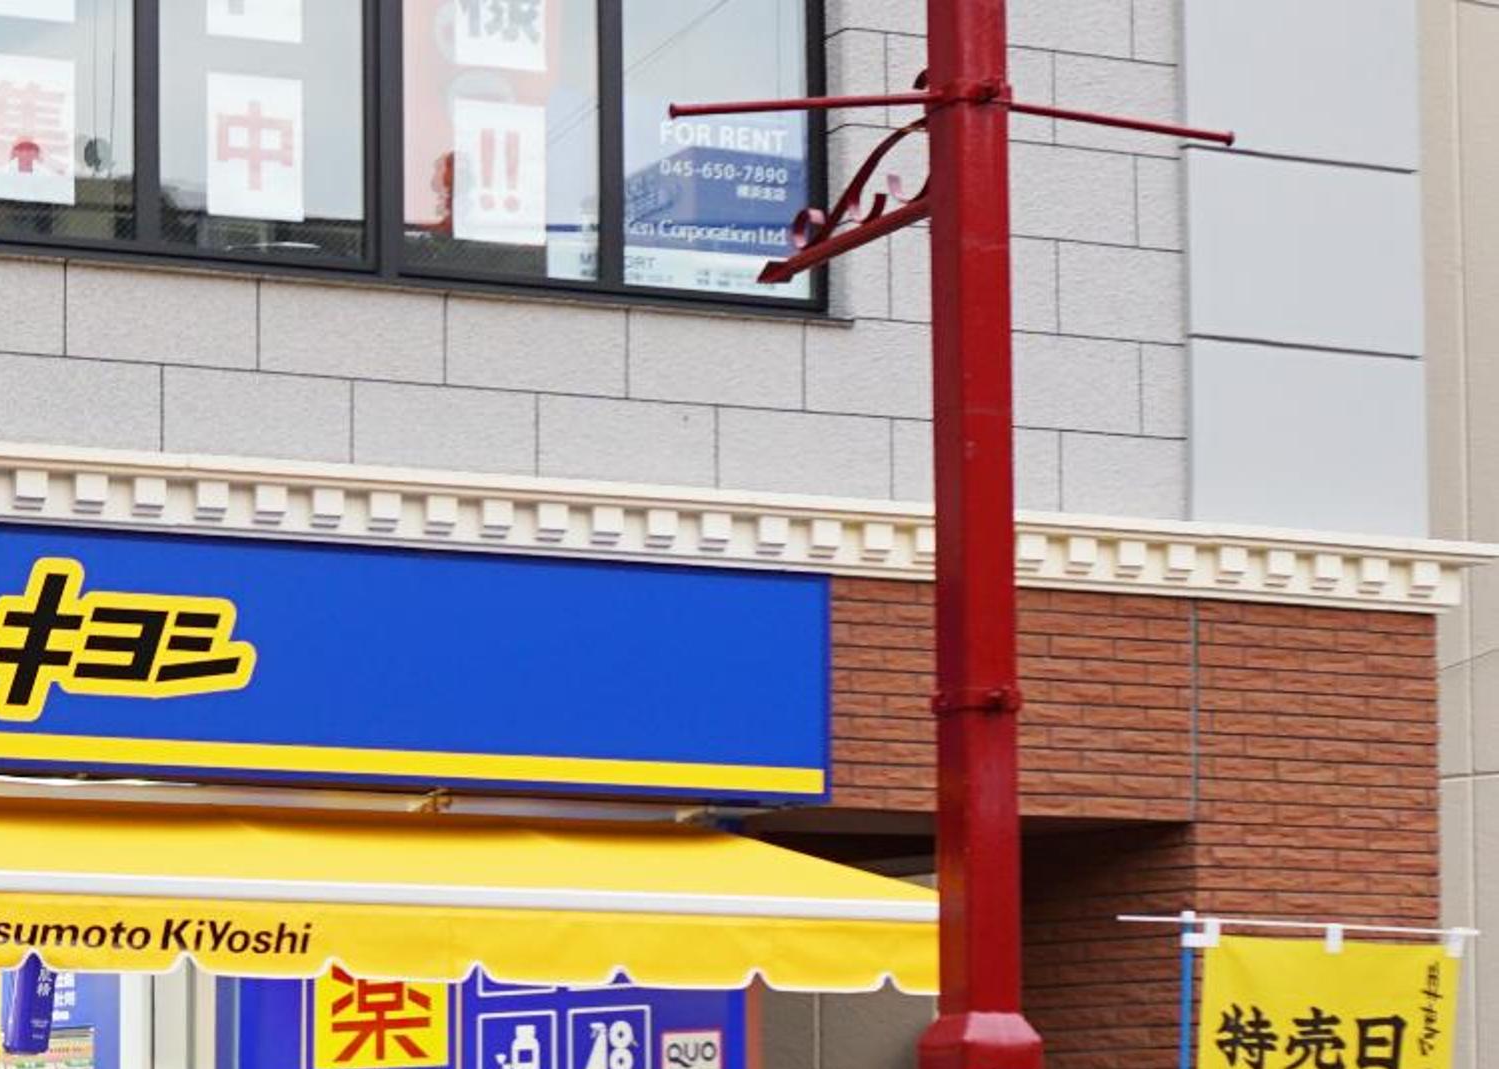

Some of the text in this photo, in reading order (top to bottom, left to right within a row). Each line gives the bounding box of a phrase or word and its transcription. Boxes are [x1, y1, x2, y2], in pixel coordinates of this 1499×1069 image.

[216, 100, 293, 191] 中
[659, 121, 788, 151] FOR RENT
[659, 159, 788, 184] 045-650-7890
[658, 219, 756, 243] Corporation
[160, 918, 313, 955] KiYoshi
[667, 1042, 717, 1067] QUO
